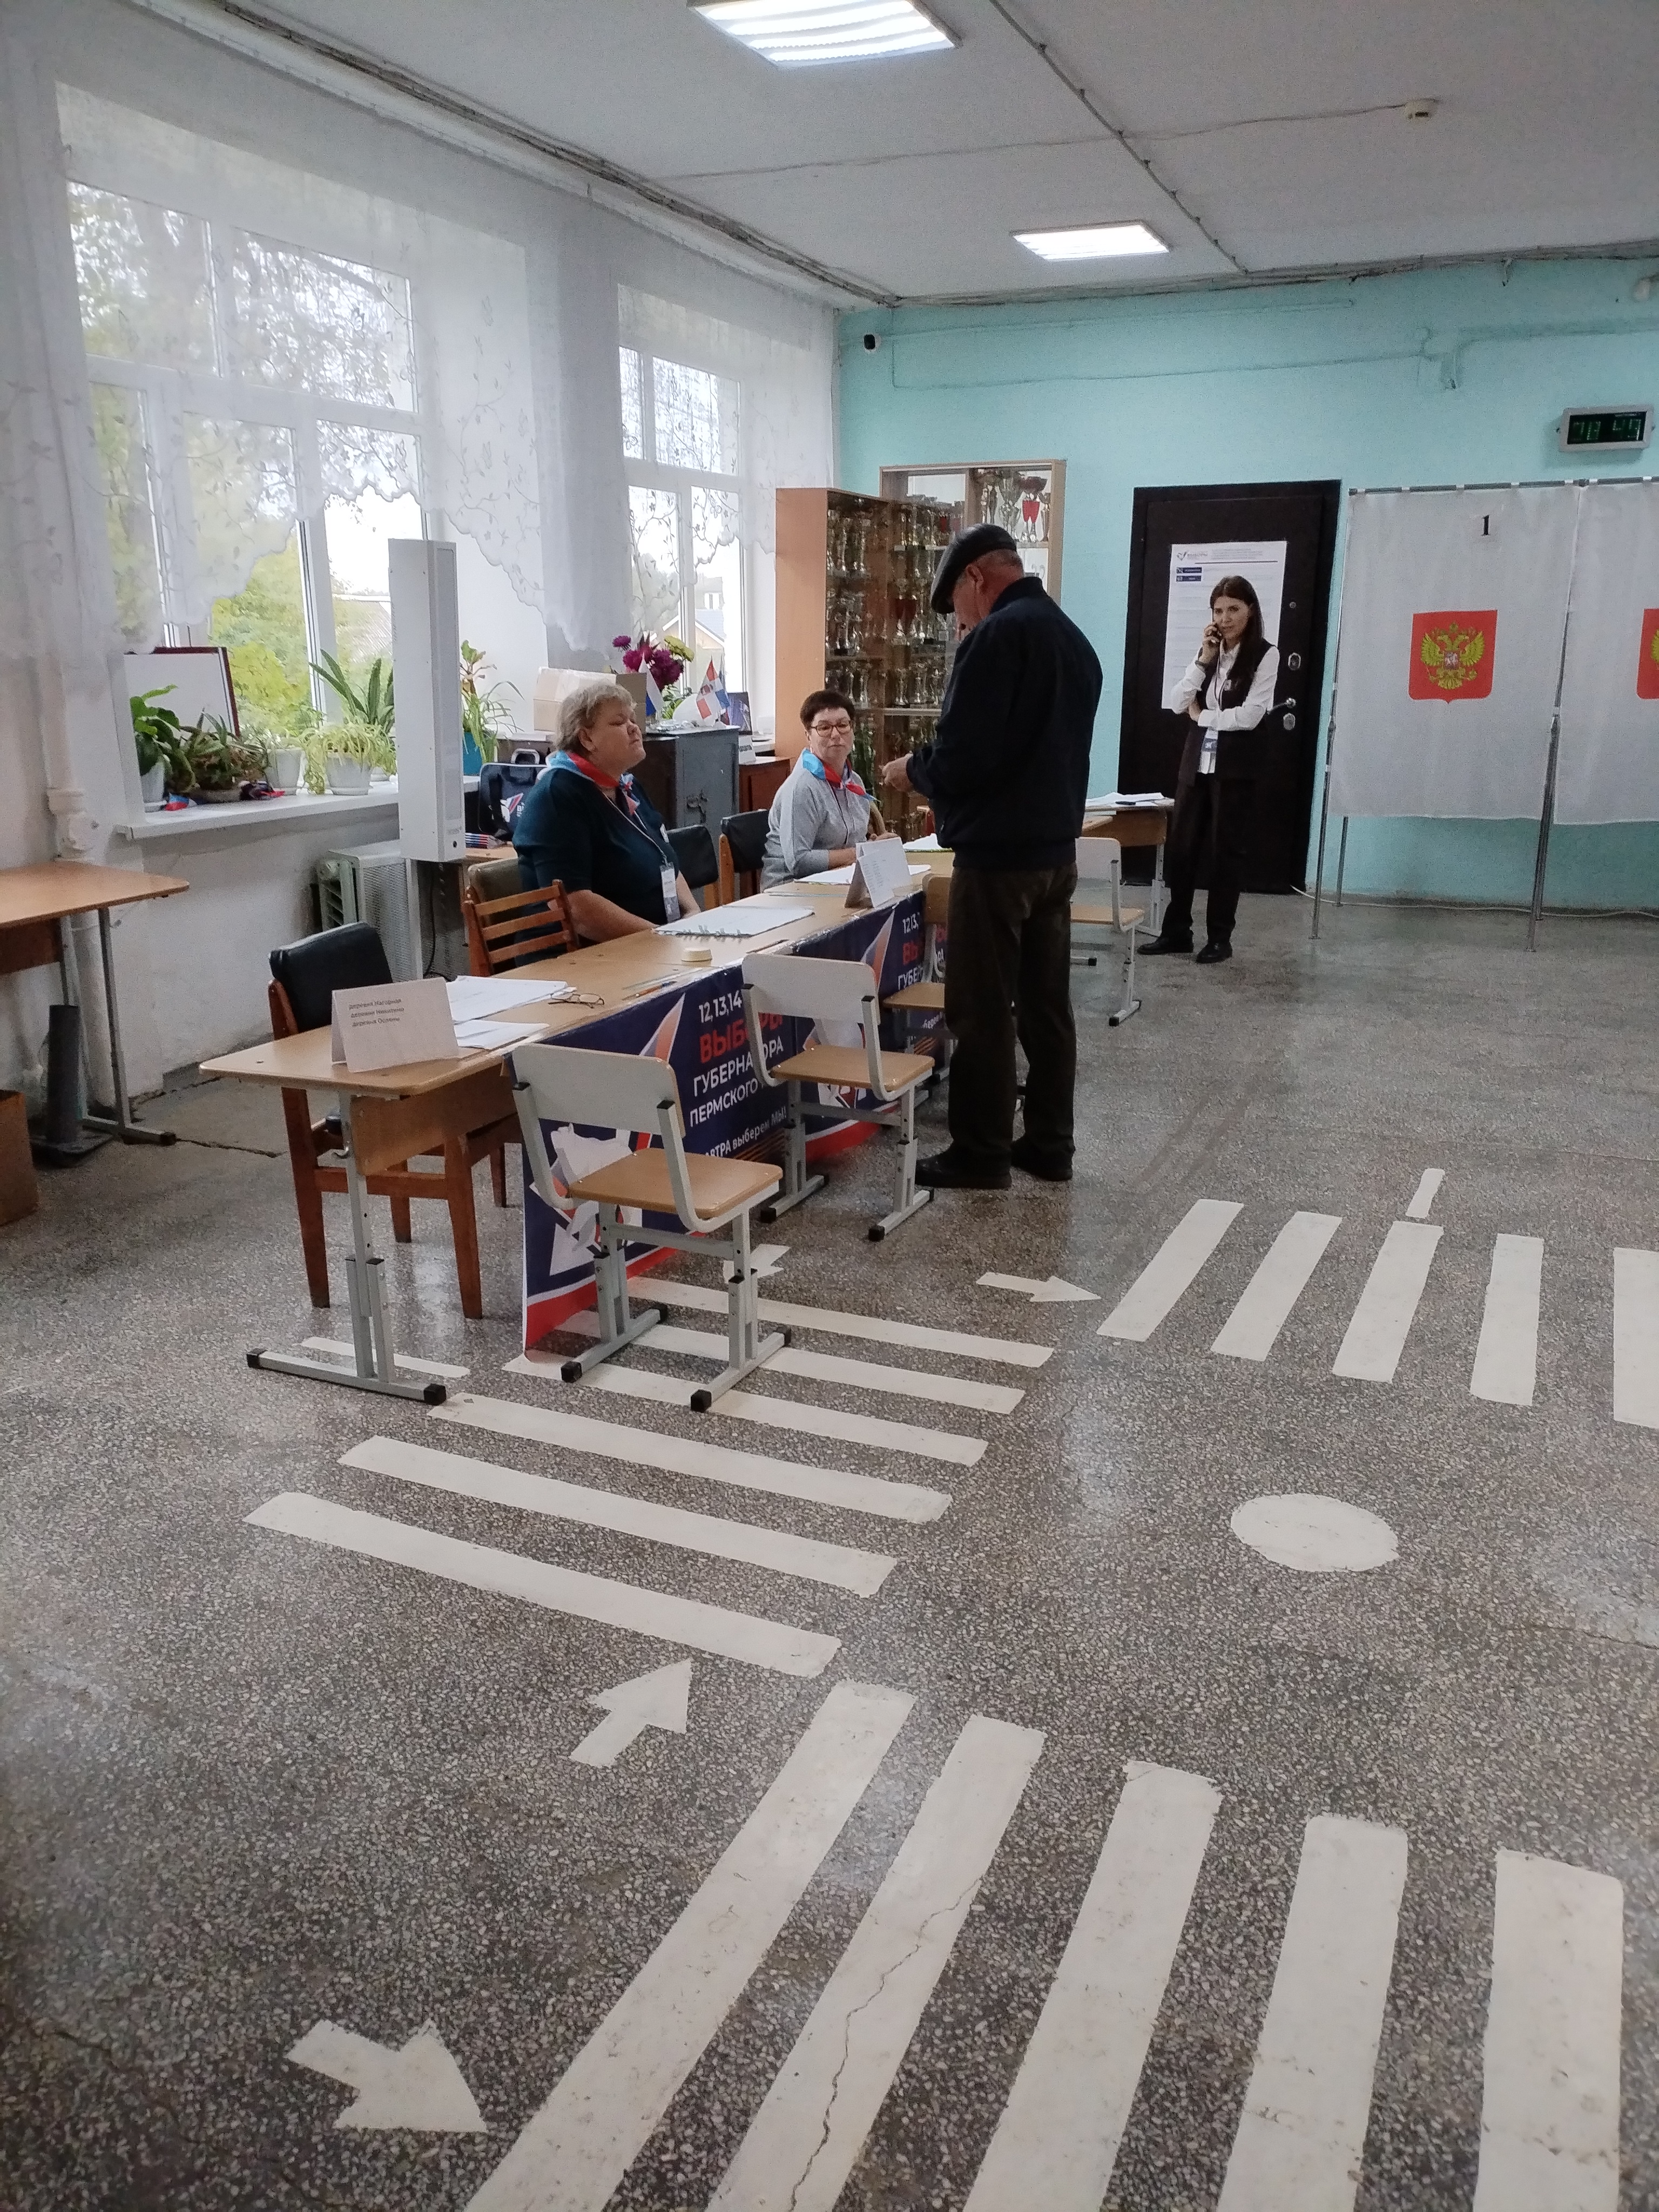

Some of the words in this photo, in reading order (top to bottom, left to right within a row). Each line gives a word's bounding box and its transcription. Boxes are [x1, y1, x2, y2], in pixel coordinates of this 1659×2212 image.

[1481, 515, 1490, 536] 1
[699, 990, 743, 1023] 12,13,14
[699, 1013, 783, 1064] ВЫБРЫ
[693, 1035, 784, 1097] ГУБЕРНАОРА
[690, 1078, 758, 1128] ПЕРМСКОГО
[732, 1120, 770, 1150] выберем
